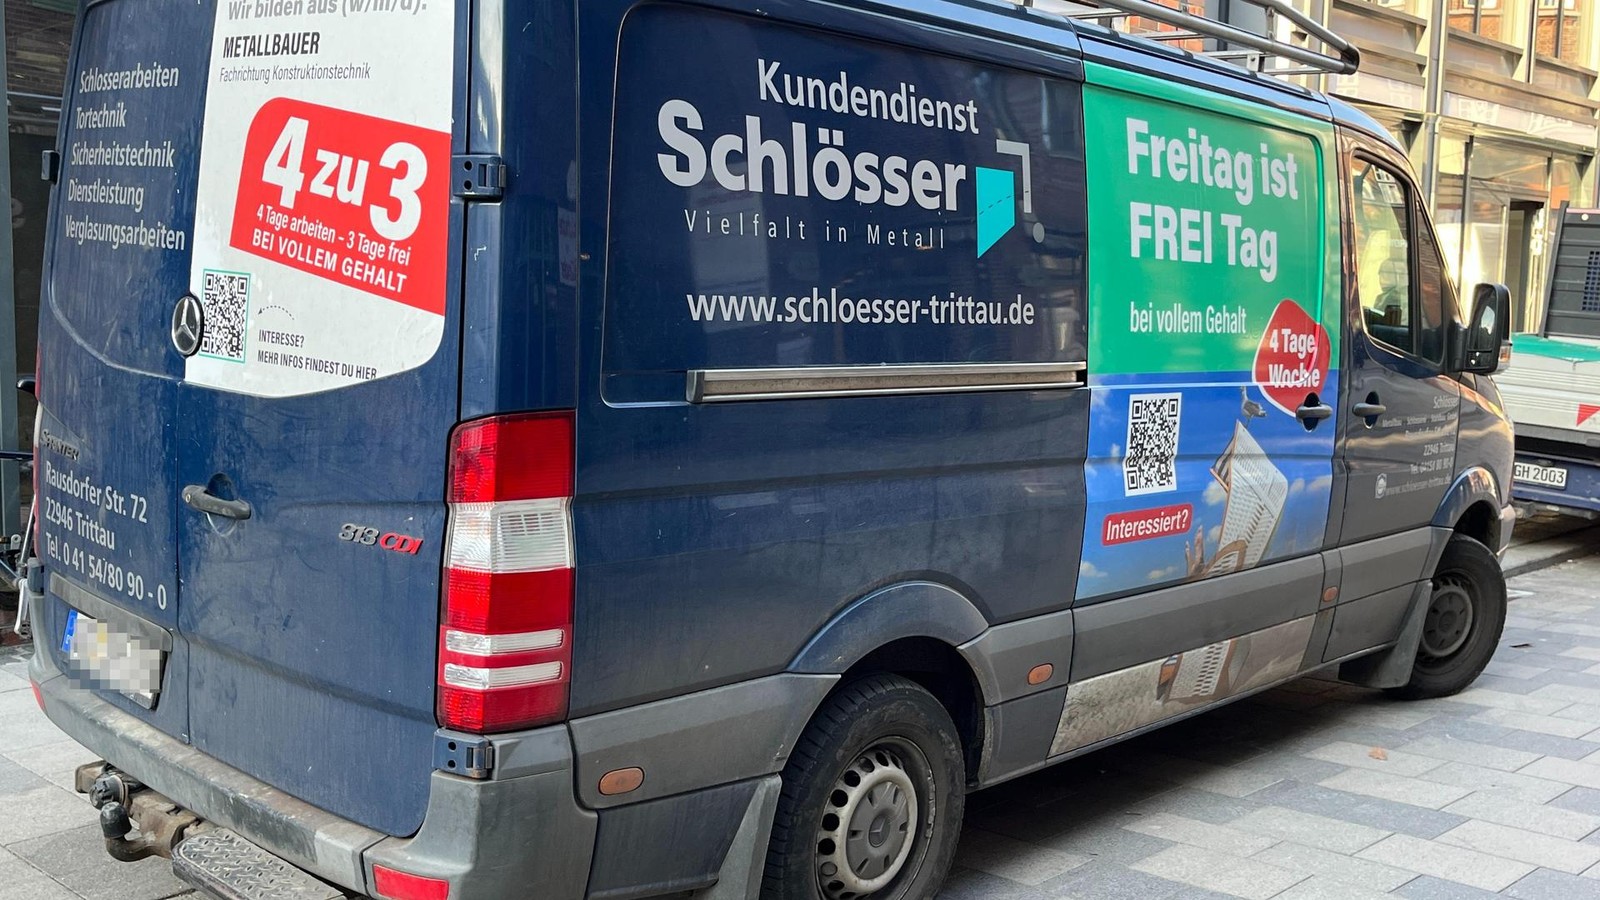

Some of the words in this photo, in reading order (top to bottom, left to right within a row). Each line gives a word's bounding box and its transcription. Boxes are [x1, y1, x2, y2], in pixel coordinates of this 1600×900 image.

[229, 1, 252, 20] Wir
[254, 0, 303, 18] bilden
[307, 0, 338, 14] aus
[223, 32, 320, 58] METALLBAUER
[79, 61, 179, 93] Schlosserarbeiten
[219, 67, 270, 84] Fachrichtung
[272, 62, 371, 81] Konstruktionstechnik
[758, 58, 979, 135] Kundendienst
[76, 102, 127, 129] Tortechnik
[71, 141, 175, 168] Sicherheitstechnik
[657, 99, 966, 212] Schlösser
[1126, 117, 1253, 205] Freitag
[1260, 143, 1298, 200] ist
[68, 178, 144, 213] Dienstleistung
[262, 116, 309, 209] 4
[309, 148, 370, 207] zu
[369, 141, 428, 241] 3
[65, 215, 185, 250] Verglasungsarbeiten
[257, 204, 264, 221] 4
[266, 205, 288, 231] Tage
[290, 216, 336, 243] arbeiten
[346, 231, 355, 249] 3
[358, 233, 385, 261] Tage
[388, 242, 411, 266] frei
[685, 209, 805, 240] Vielfalt
[826, 220, 847, 243] in
[867, 224, 944, 249] Metall
[1130, 201, 1212, 264] FREI
[1221, 213, 1277, 282] Tag
[252, 228, 275, 251] BEI
[278, 236, 338, 272] VOLLEM
[341, 257, 407, 293] GEHALT
[687, 287, 1034, 325] www.schloesser-trittau.de
[1130, 301, 1152, 333] bei
[1157, 303, 1202, 333] vollem
[1206, 305, 1246, 334] Gehalt
[259, 329, 305, 348] INTERESSE?
[1269, 329, 1279, 353] 4
[1281, 328, 1316, 359] Tage
[257, 350, 279, 365] MEHR
[280, 353, 303, 370] INFOS
[305, 358, 340, 375] FINDEST
[341, 363, 354, 377] DU
[355, 365, 377, 380] HIER
[1268, 362, 1320, 388] Woche
[1515, 464, 1529, 478] GH
[1533, 467, 1565, 484] 2003
[46, 460, 102, 506] Rausdorfer
[105, 485, 126, 516] Str.
[130, 493, 147, 523] 72
[46, 496, 73, 531] 22946
[75, 511, 115, 550] Trittau
[1107, 509, 1188, 541] Interessiert?
[380, 532, 423, 555] CDI
[46, 532, 61, 561] Tel.
[63, 542, 69, 565] 0
[72, 547, 85, 574] 41
[88, 554, 123, 592] 54/80
[127, 571, 144, 601] 90
[157, 584, 166, 610] 0
